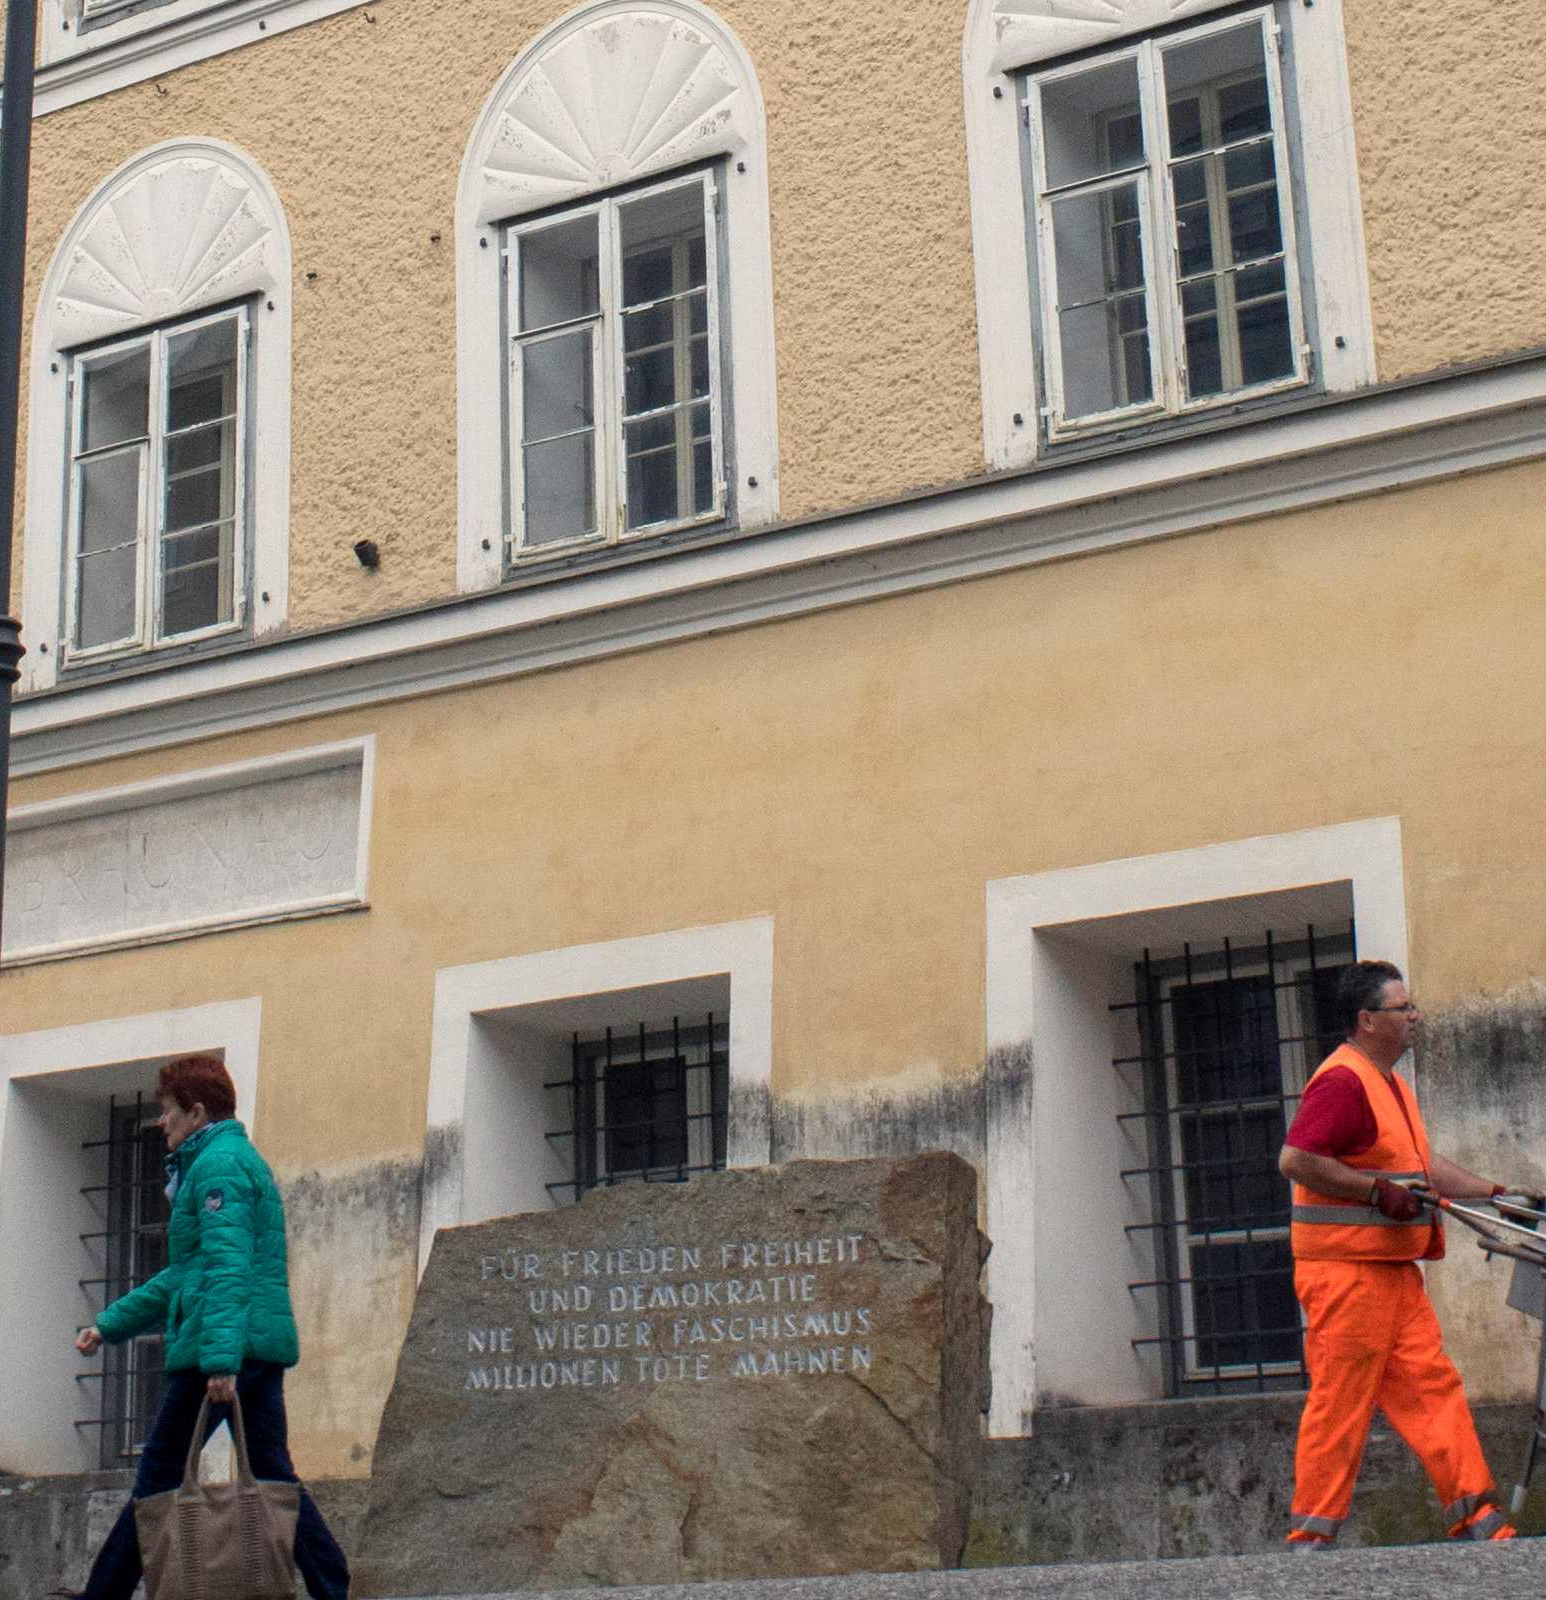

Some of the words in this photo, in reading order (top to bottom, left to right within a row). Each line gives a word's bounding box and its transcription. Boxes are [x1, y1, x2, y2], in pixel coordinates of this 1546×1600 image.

[480, 1249, 542, 1280] FÜR
[561, 1245, 701, 1276] FRIEDEN
[720, 1233, 863, 1269] FREIHEIT
[529, 1285, 592, 1314] UND
[609, 1274, 815, 1312] DEMOKRATIE
[467, 1327, 514, 1353] NIE
[533, 1319, 650, 1350] WIEDER
[673, 1307, 871, 1344] FASCHISMUS
[464, 1356, 620, 1390] MILLIONEN
[635, 1353, 710, 1383] TOTE
[735, 1343, 871, 1377] MAHNEN
